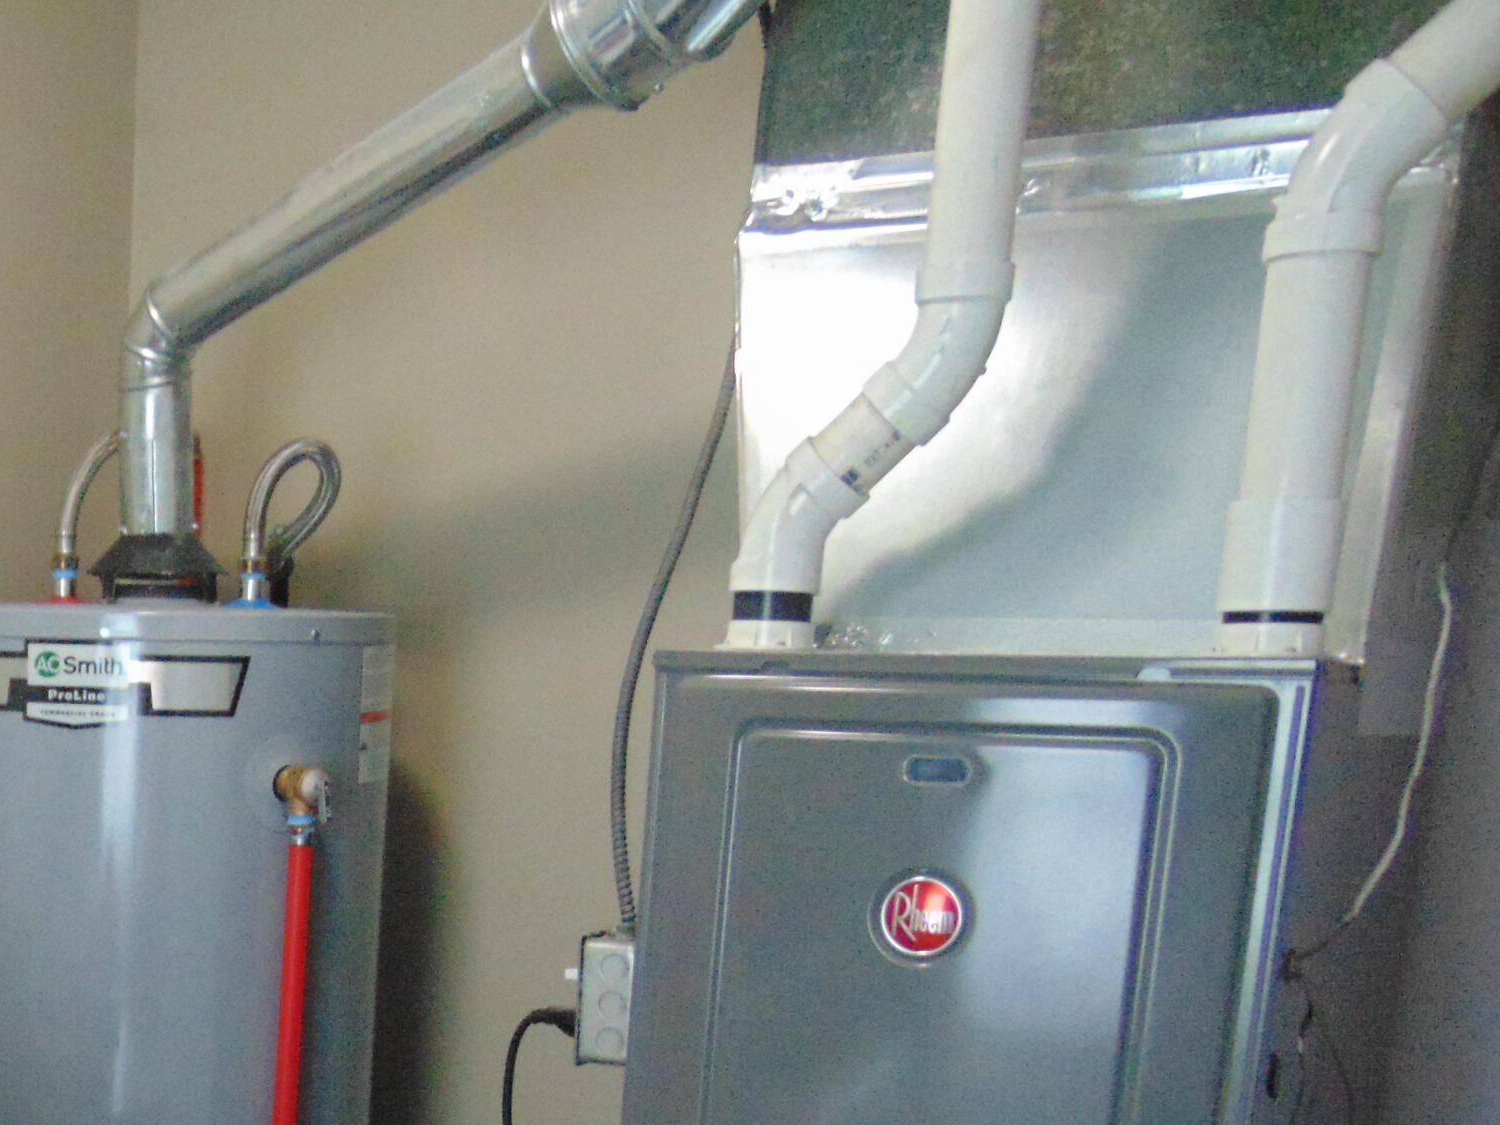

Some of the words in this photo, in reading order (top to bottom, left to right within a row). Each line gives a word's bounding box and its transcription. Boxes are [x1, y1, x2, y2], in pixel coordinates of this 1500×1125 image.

[63, 656, 123, 676] Smith
[48, 688, 106, 702] ProLine
[891, 884, 955, 941] Rheem
